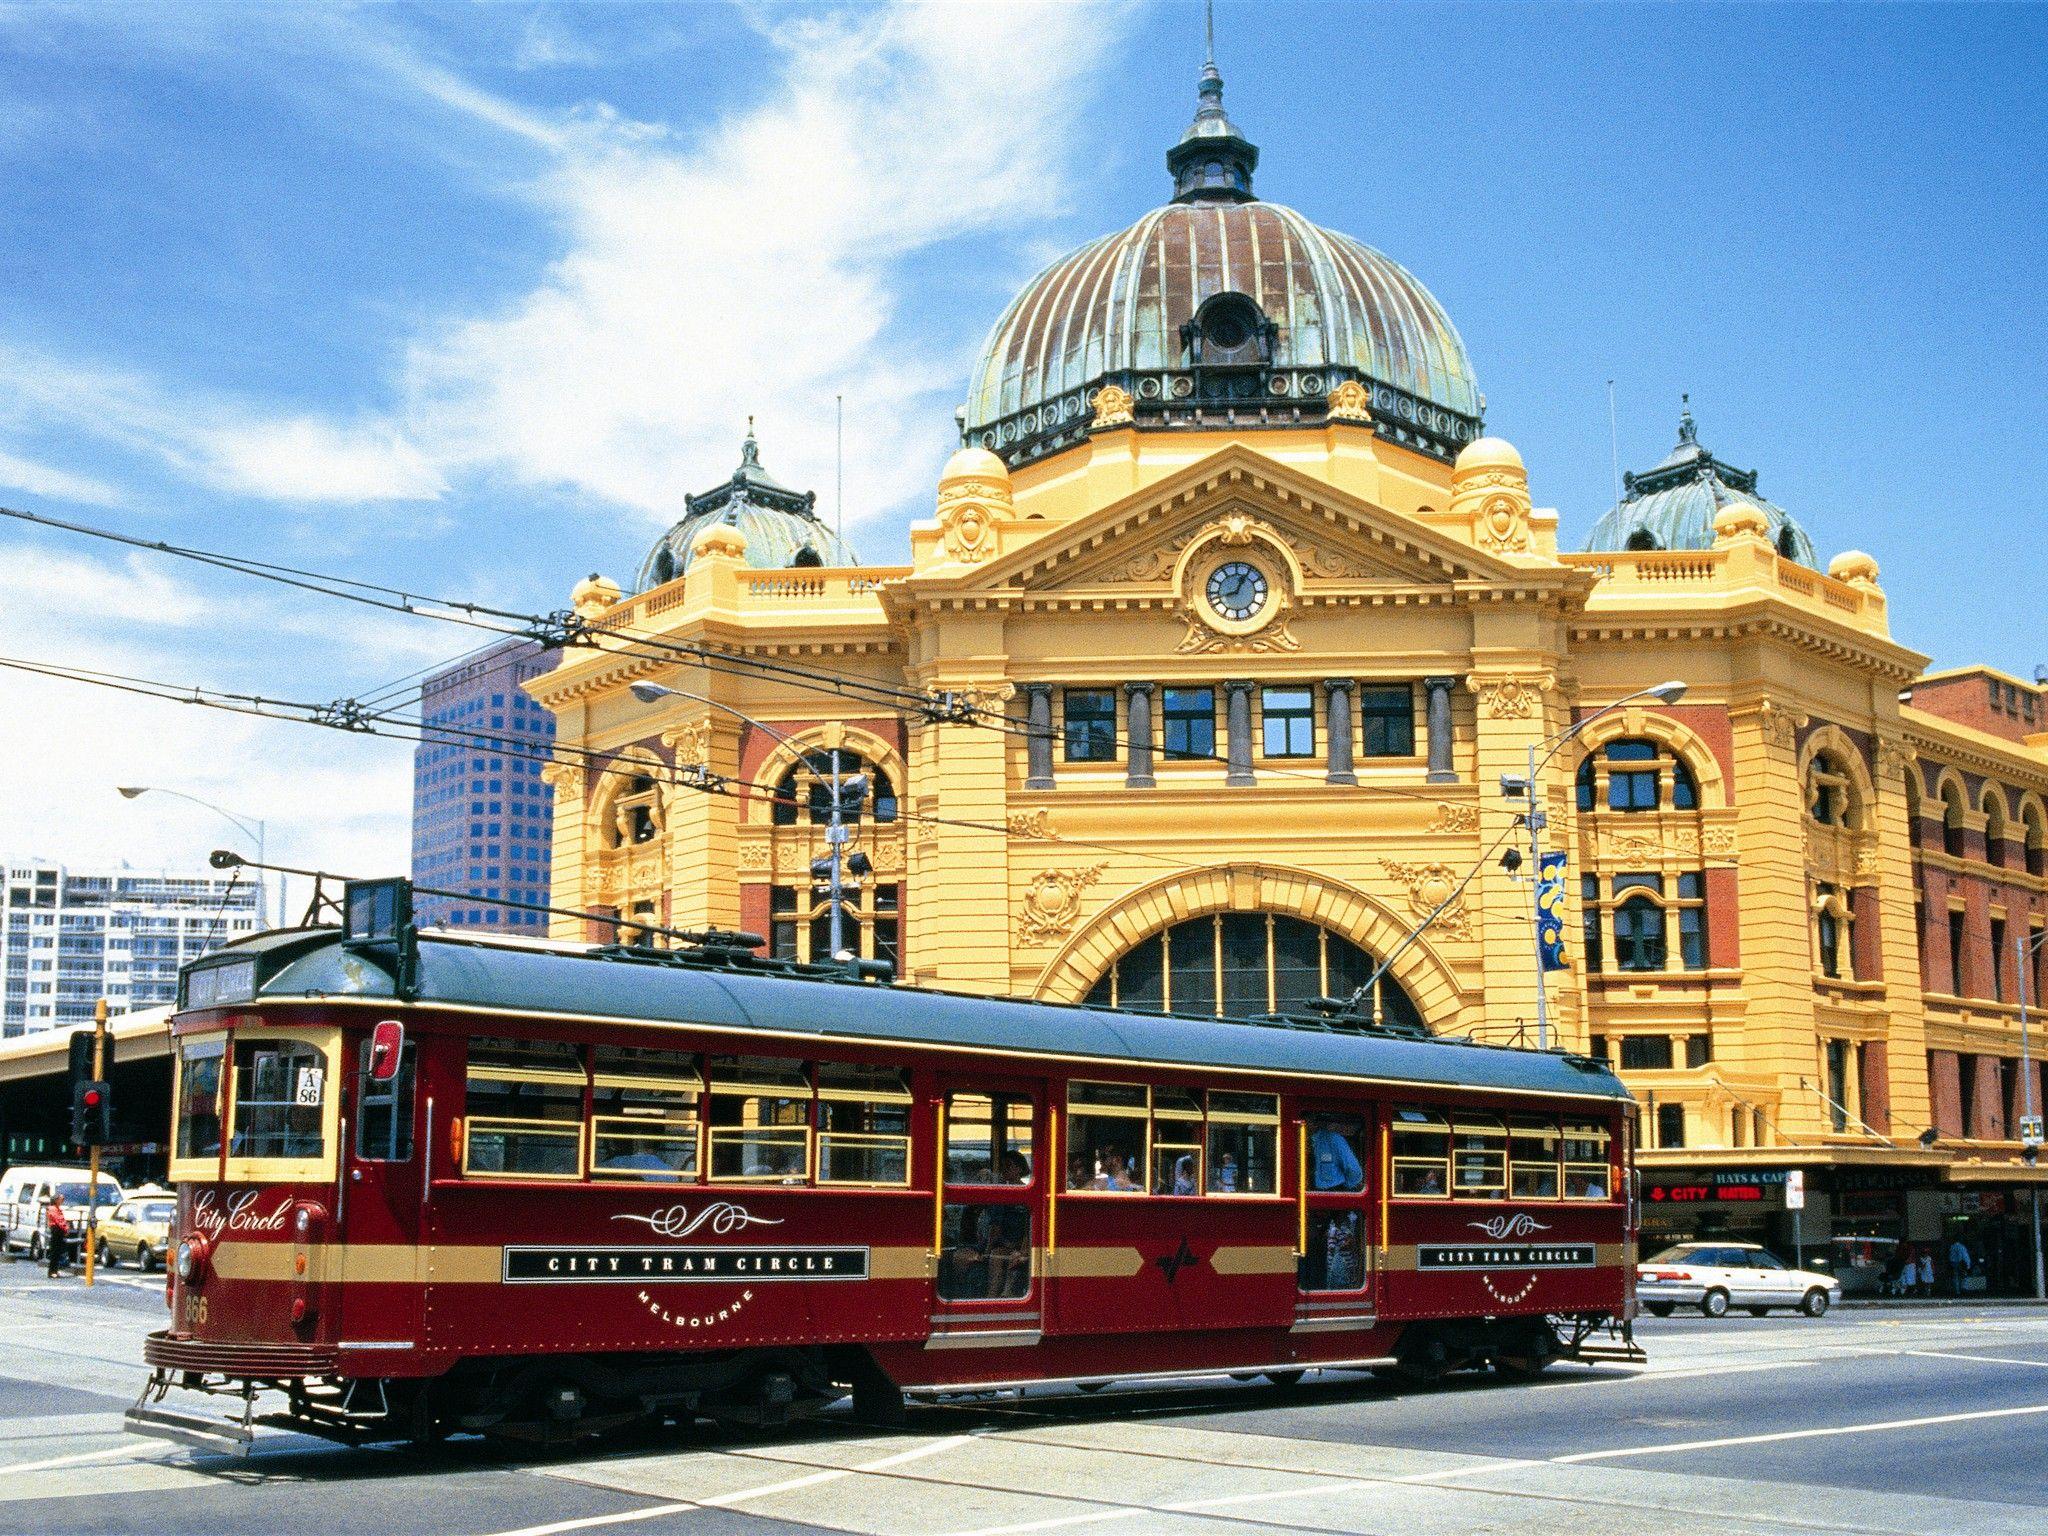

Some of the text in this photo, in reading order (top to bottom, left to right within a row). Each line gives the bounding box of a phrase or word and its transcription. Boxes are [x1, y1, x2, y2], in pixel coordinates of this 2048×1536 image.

[304, 1074, 315, 1088] A
[299, 1088, 317, 1104] 86
[1716, 1172, 1787, 1184] HATS & CAP
[1670, 1187, 1709, 1200] CITY
[194, 1190, 294, 1241] City Circle
[1438, 1250, 1579, 1262] CITY TRAM CIRCLE
[549, 1257, 833, 1271] CITY TRAM CIRCLE
[1482, 1274, 1537, 1304] MELBOURNE
[186, 1295, 208, 1324] 866
[638, 1290, 753, 1327] MELBOURNE
